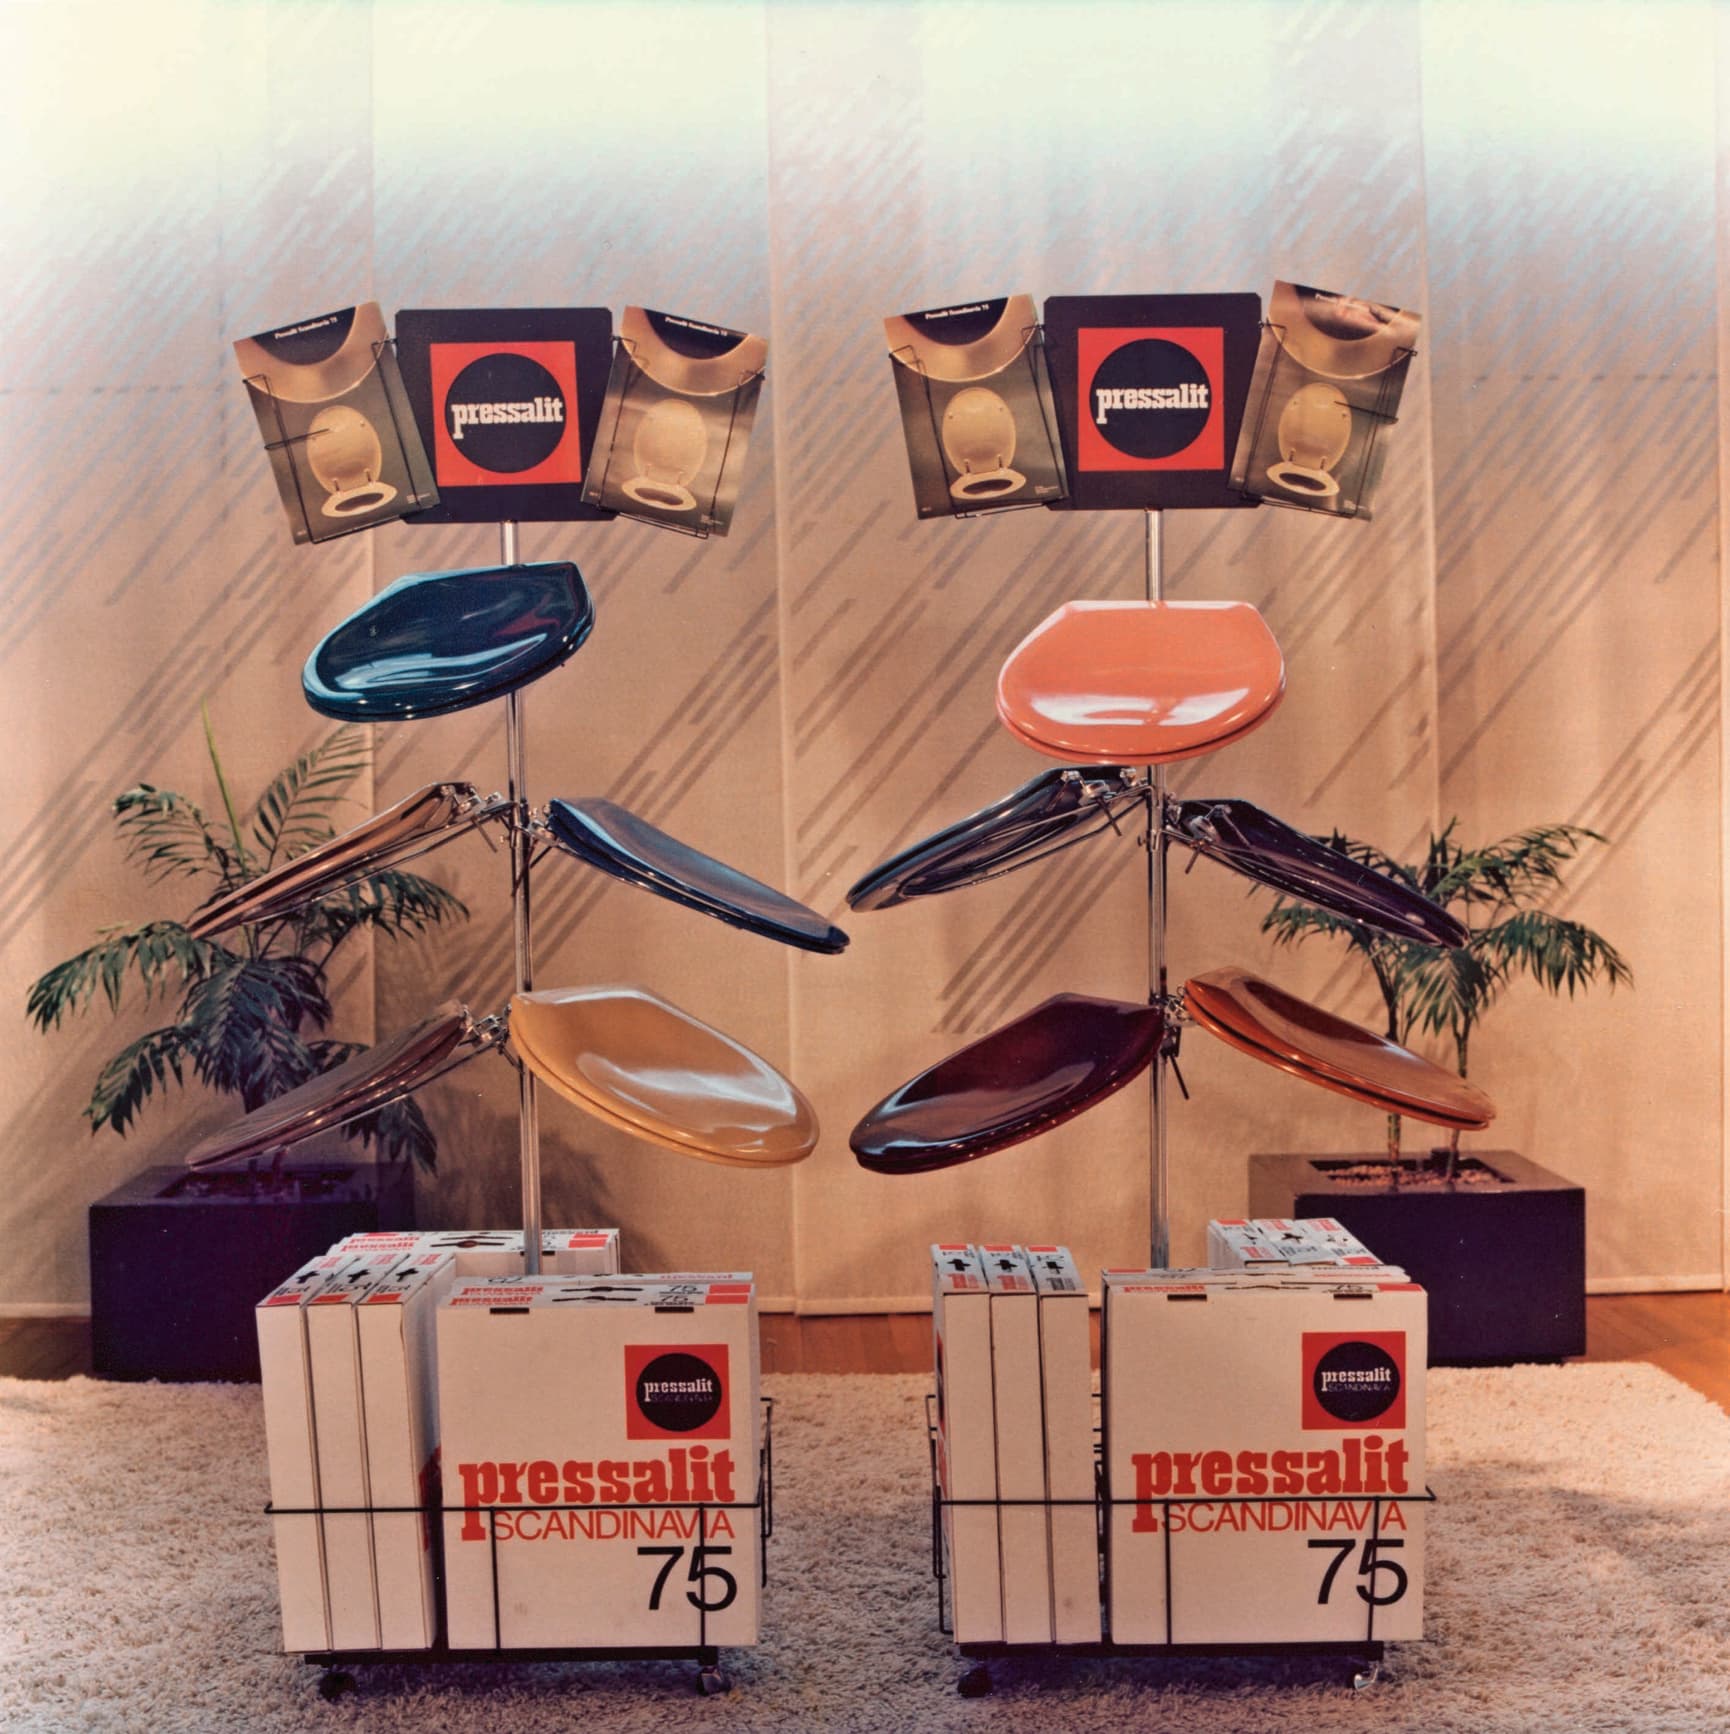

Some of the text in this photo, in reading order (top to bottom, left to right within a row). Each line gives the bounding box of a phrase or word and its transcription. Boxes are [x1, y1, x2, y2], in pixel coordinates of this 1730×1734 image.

[450, 397, 564, 440] pressalit
[1096, 383, 1209, 425] pressalit
[643, 1378, 713, 1402] pressalit
[1321, 1367, 1391, 1392] pressalit
[458, 1445, 735, 1541] pressalit
[1131, 1434, 1409, 1533] pressalit
[492, 1510, 735, 1541] SCANDINAVIA
[1162, 1500, 1407, 1532] SCANDINAVA
[637, 1545, 739, 1611] 75
[1307, 1538, 1408, 1605] 75
